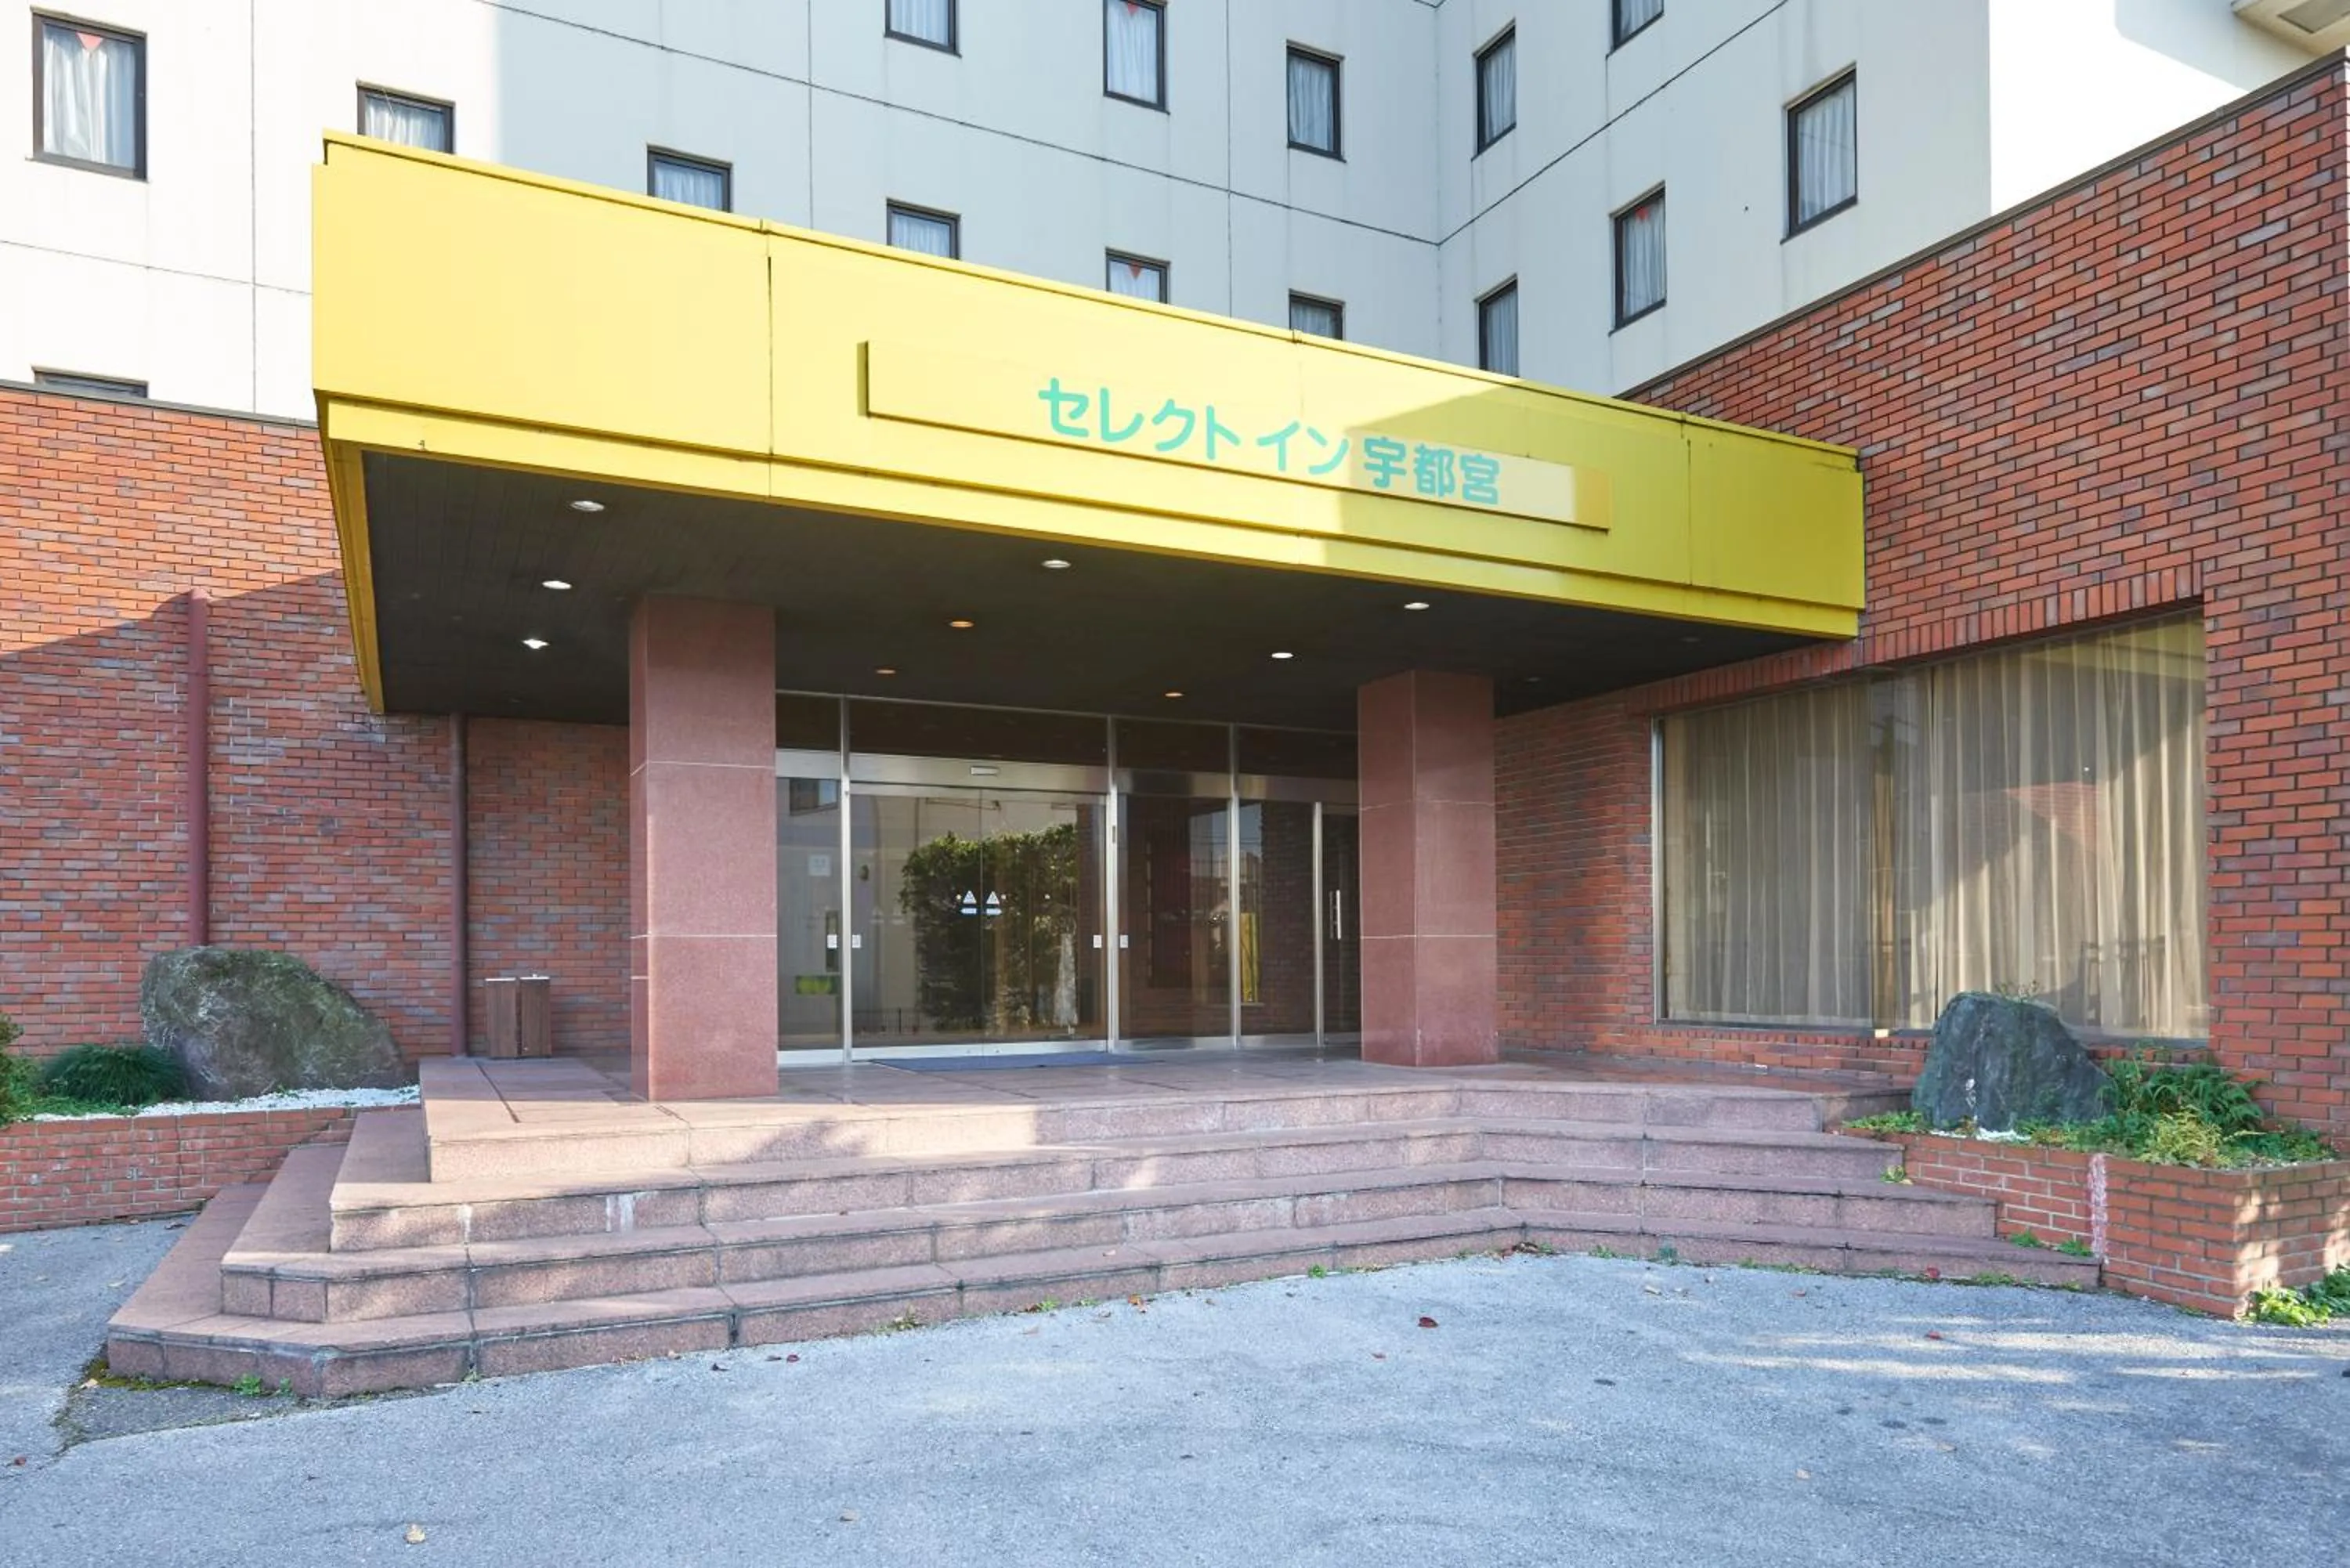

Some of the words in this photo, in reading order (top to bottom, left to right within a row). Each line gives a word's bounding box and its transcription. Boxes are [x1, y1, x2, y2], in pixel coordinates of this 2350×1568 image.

[1038, 377, 1501, 506] セレクトイン宇都宮
